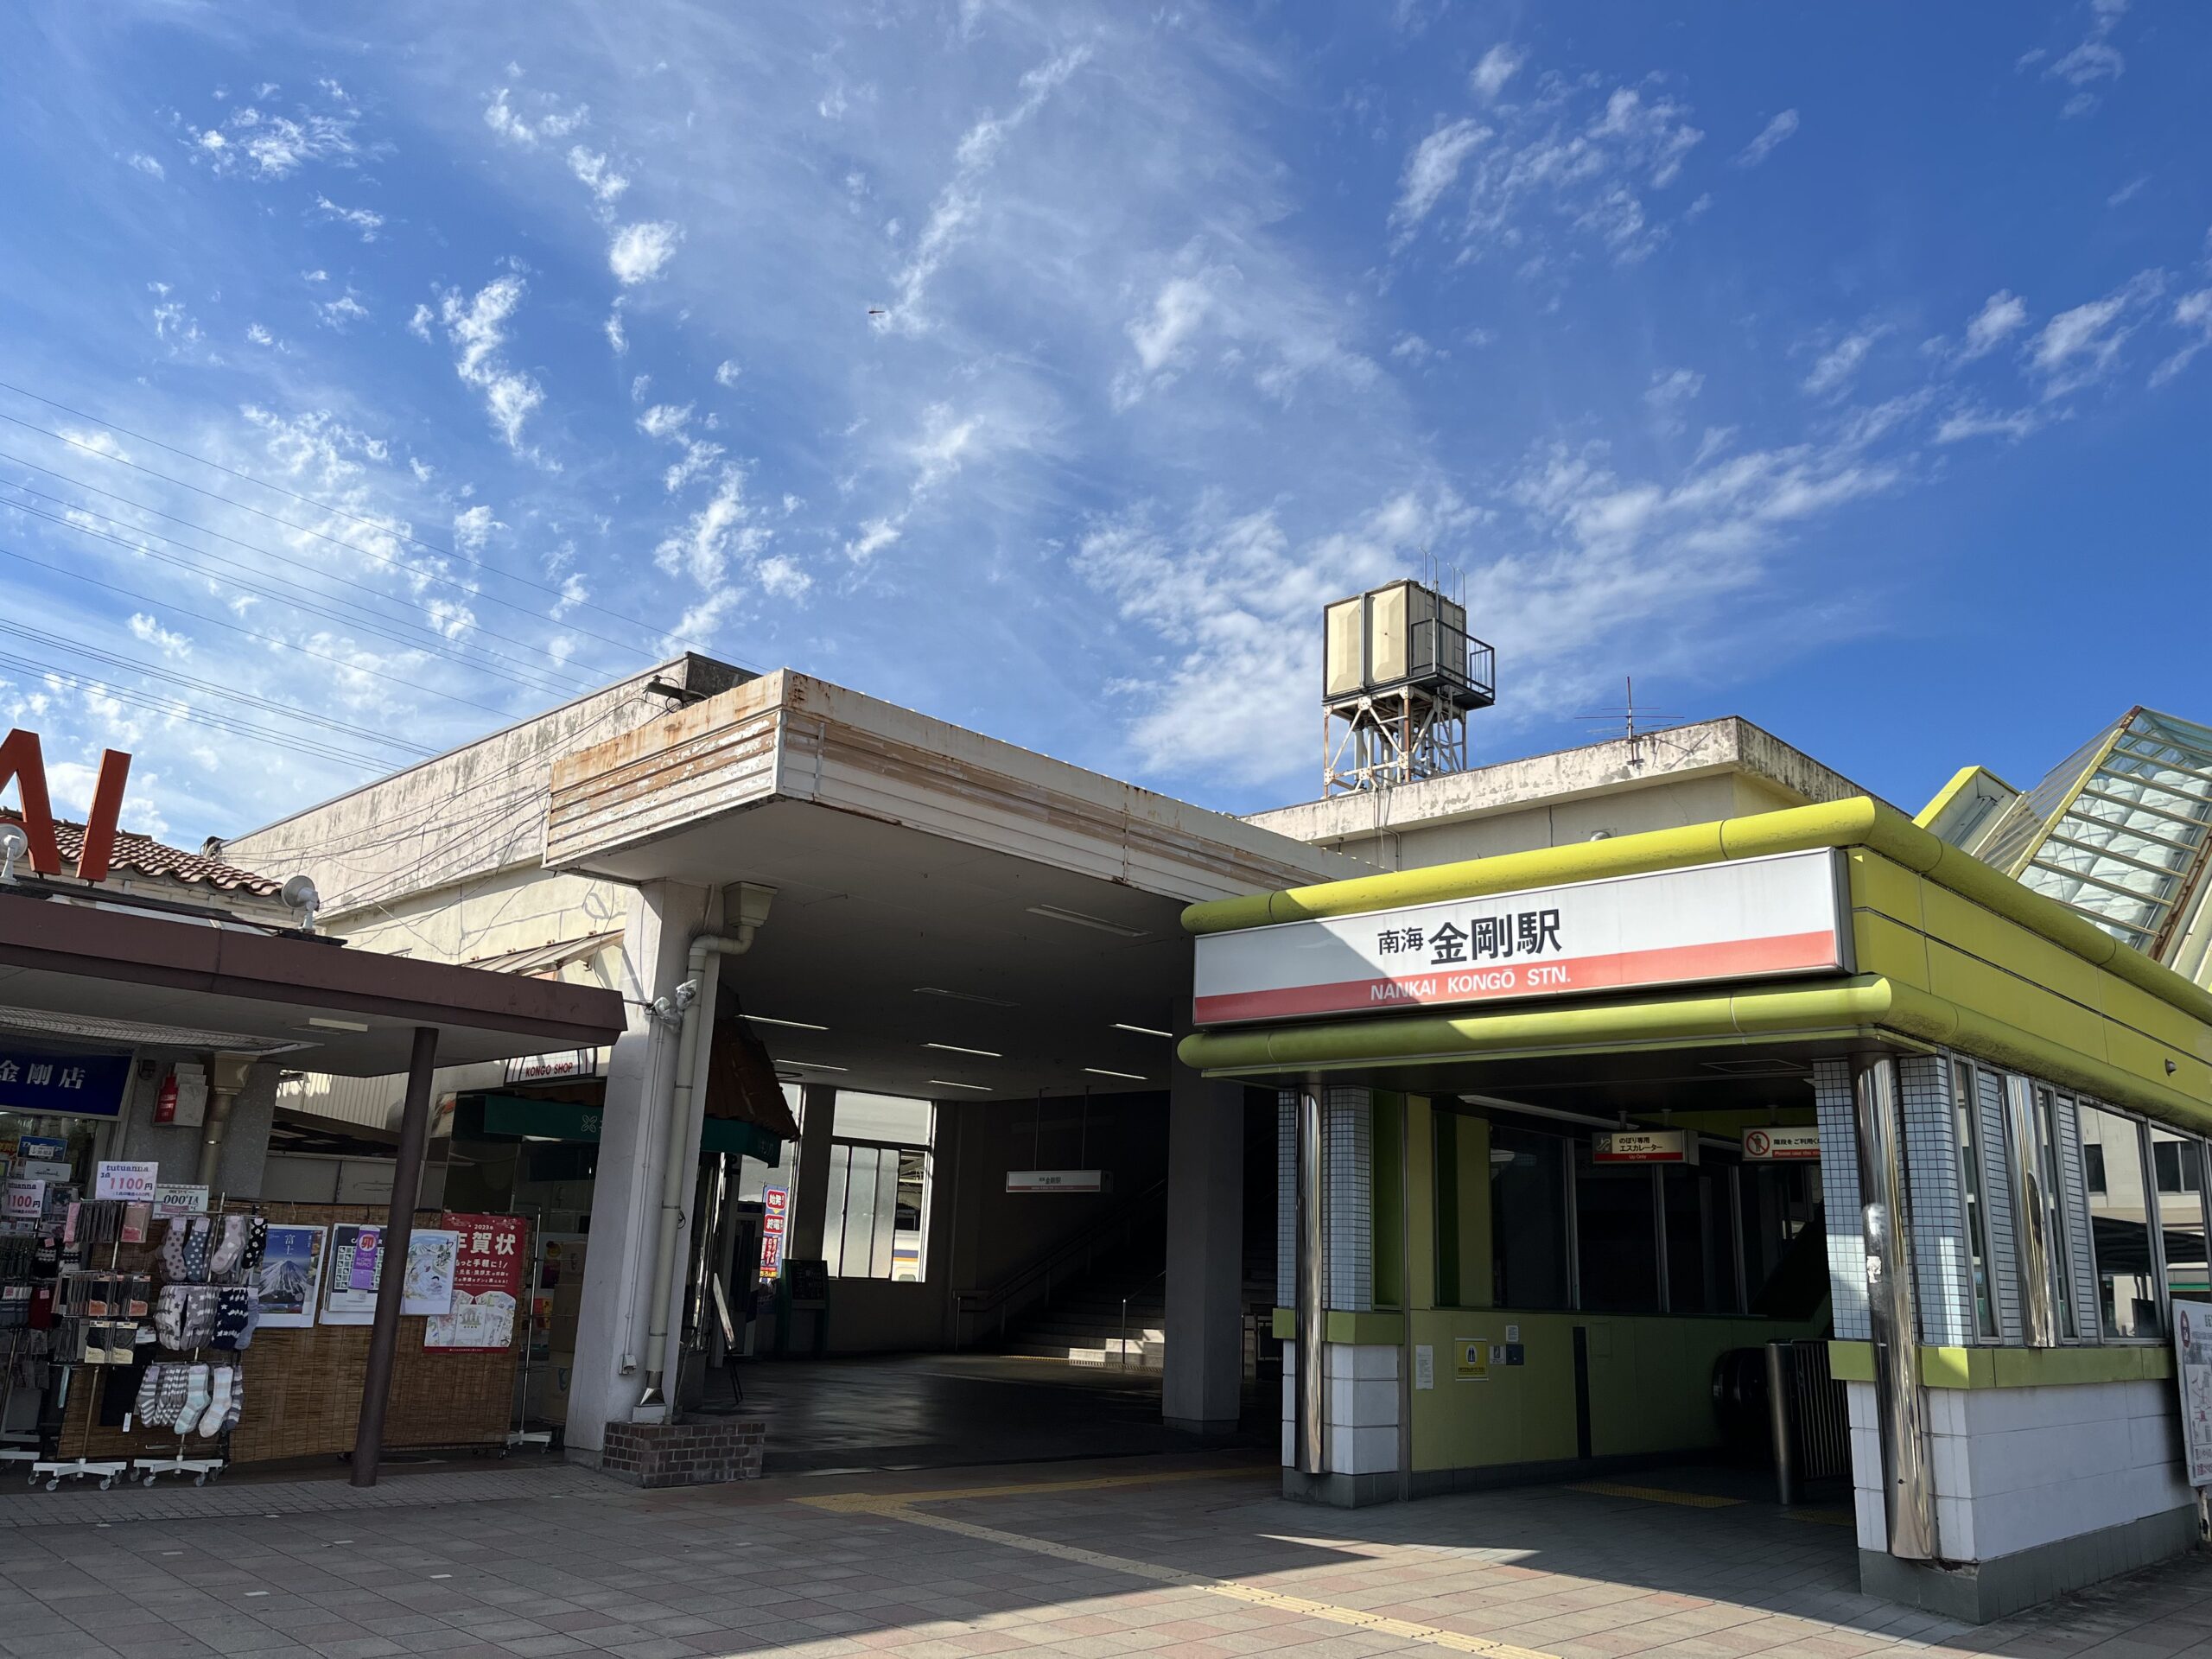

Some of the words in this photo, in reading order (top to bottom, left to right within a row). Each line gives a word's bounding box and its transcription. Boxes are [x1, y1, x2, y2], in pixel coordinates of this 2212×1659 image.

[1377, 927, 1424, 956] 南海
[1428, 909, 1562, 965] 金剛駅
[1370, 977, 1437, 1001] NANKAI
[1527, 965, 1572, 988] STN.
[0, 1059, 86, 1090] 金剛店
[525, 1064, 552, 1077] KONGO
[554, 1062, 573, 1075] SHOP
[106, 1164, 149, 1173] tutuanna
[110, 1178, 153, 1191] 1100円
